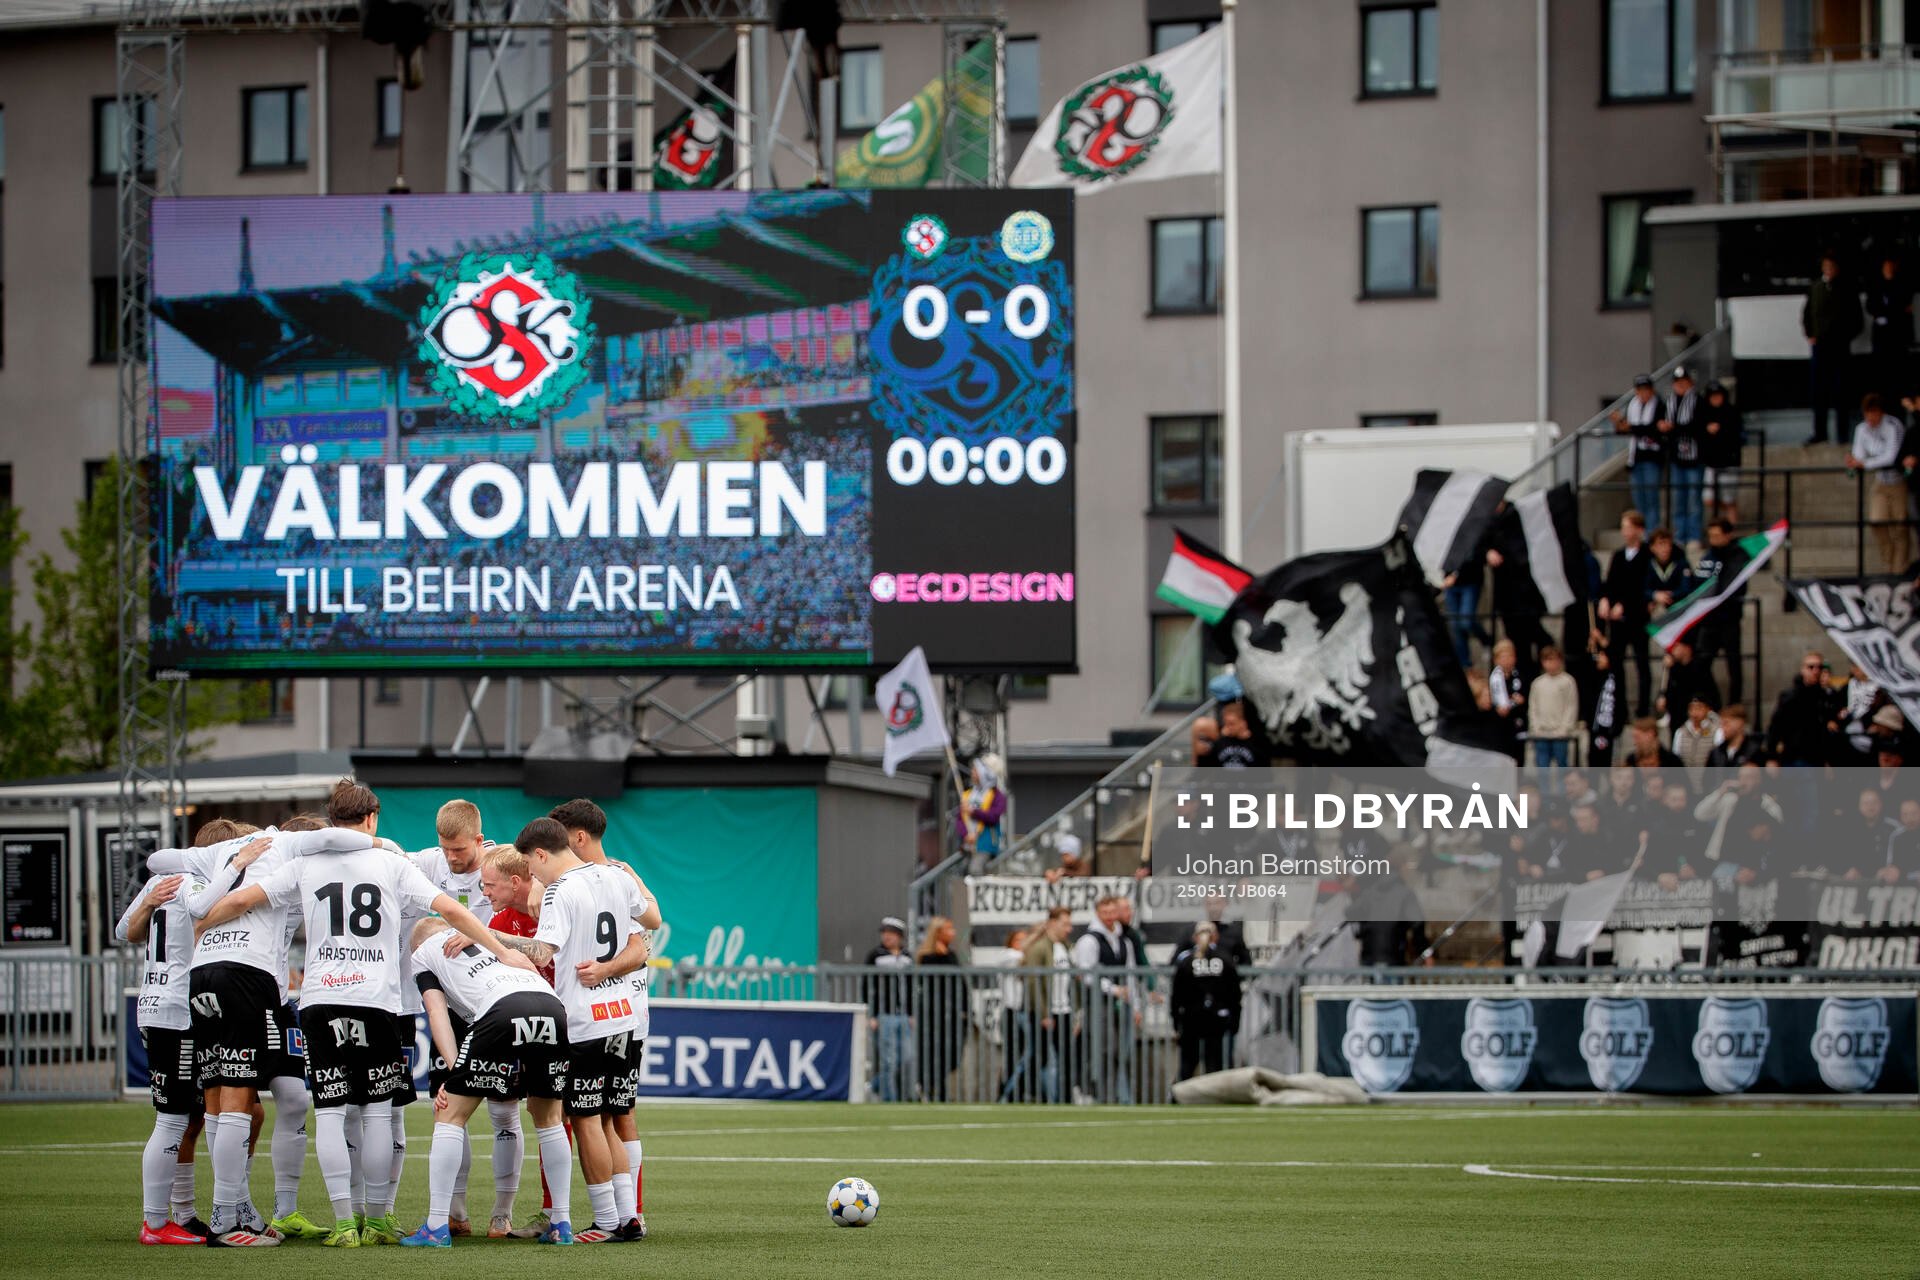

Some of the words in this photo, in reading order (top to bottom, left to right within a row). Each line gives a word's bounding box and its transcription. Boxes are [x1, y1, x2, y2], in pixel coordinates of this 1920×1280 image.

[902, 284, 948, 340] 0
[1003, 284, 1050, 340] 0
[886, 436, 1067, 486] 00:00
[193, 443, 828, 541] VÄLKOMMEN
[275, 567, 368, 614] TILL
[382, 565, 552, 613] BEHRN
[566, 564, 742, 611] ARENA
[314, 882, 382, 937] 18
[202, 930, 250, 946] GÖRTZ
[596, 911, 618, 963] 9
[318, 947, 385, 962] HRASTOVINA
[486, 973, 538, 991] ERNST
[511, 1016, 558, 1046] NA
[1348, 1032, 1415, 1058] GOLF
[1466, 1031, 1532, 1058] GOLF
[1584, 1031, 1649, 1058] GOLF
[1699, 1031, 1765, 1059] GOLF
[1816, 1031, 1886, 1059] GOLF
[368, 1061, 409, 1080] EXACT
[470, 1058, 514, 1077] EXACT
